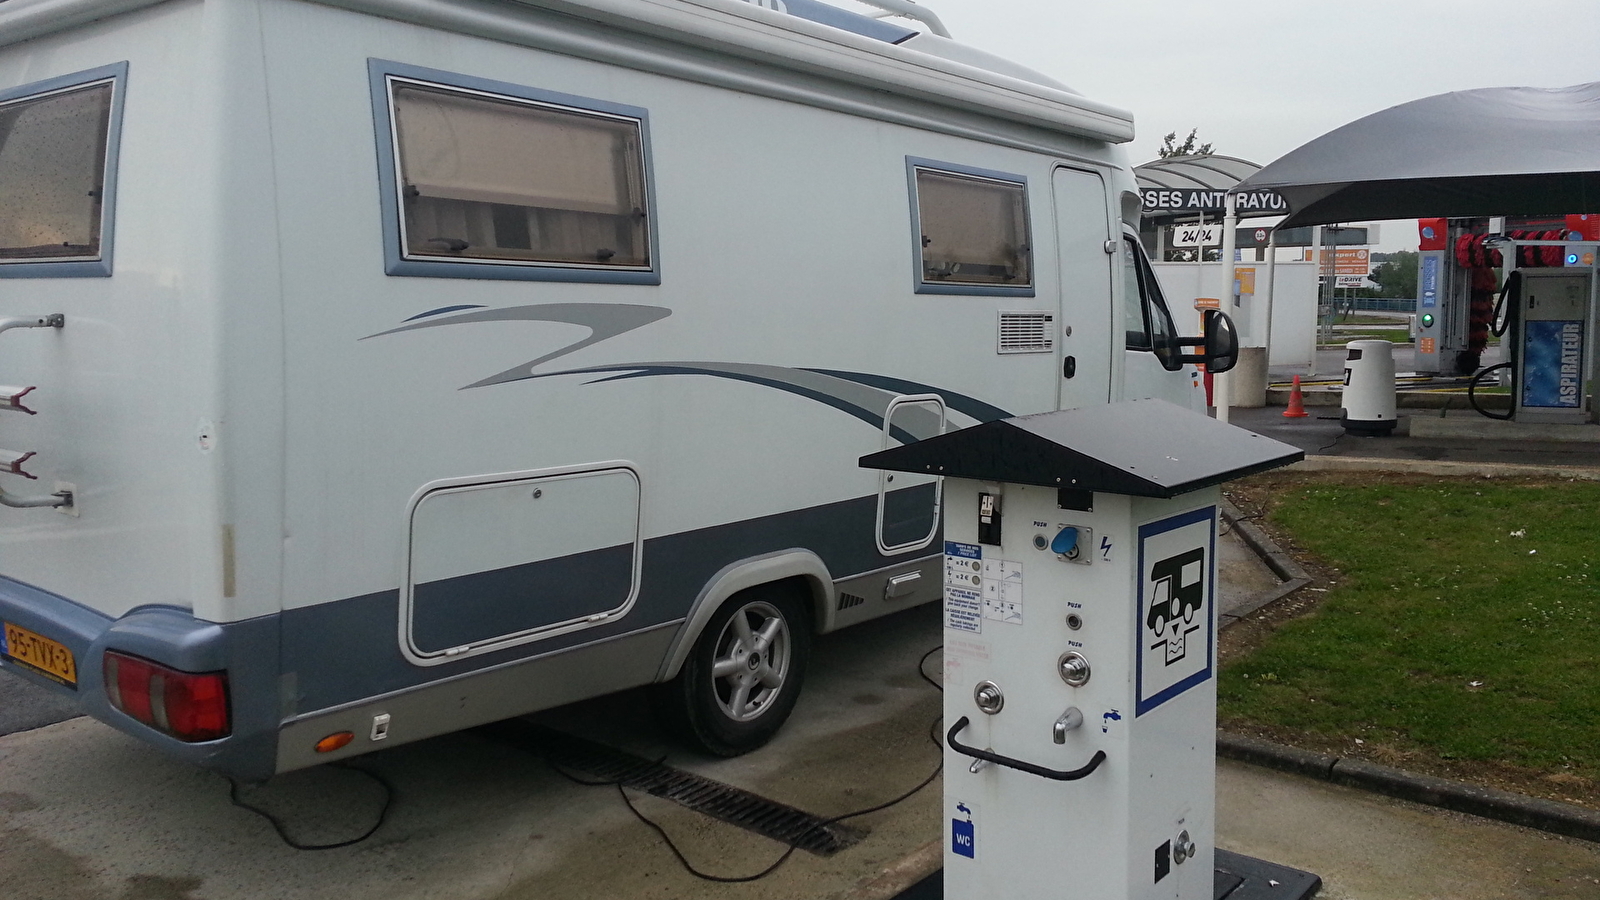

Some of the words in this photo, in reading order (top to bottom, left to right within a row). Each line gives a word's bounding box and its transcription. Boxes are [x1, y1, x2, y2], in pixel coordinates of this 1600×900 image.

[1182, 230, 1212, 242] 24/24
[1560, 324, 1580, 404] ASPIRATEUR
[9, 628, 68, 674] 95-TVX-3
[956, 832, 970, 848] WC
